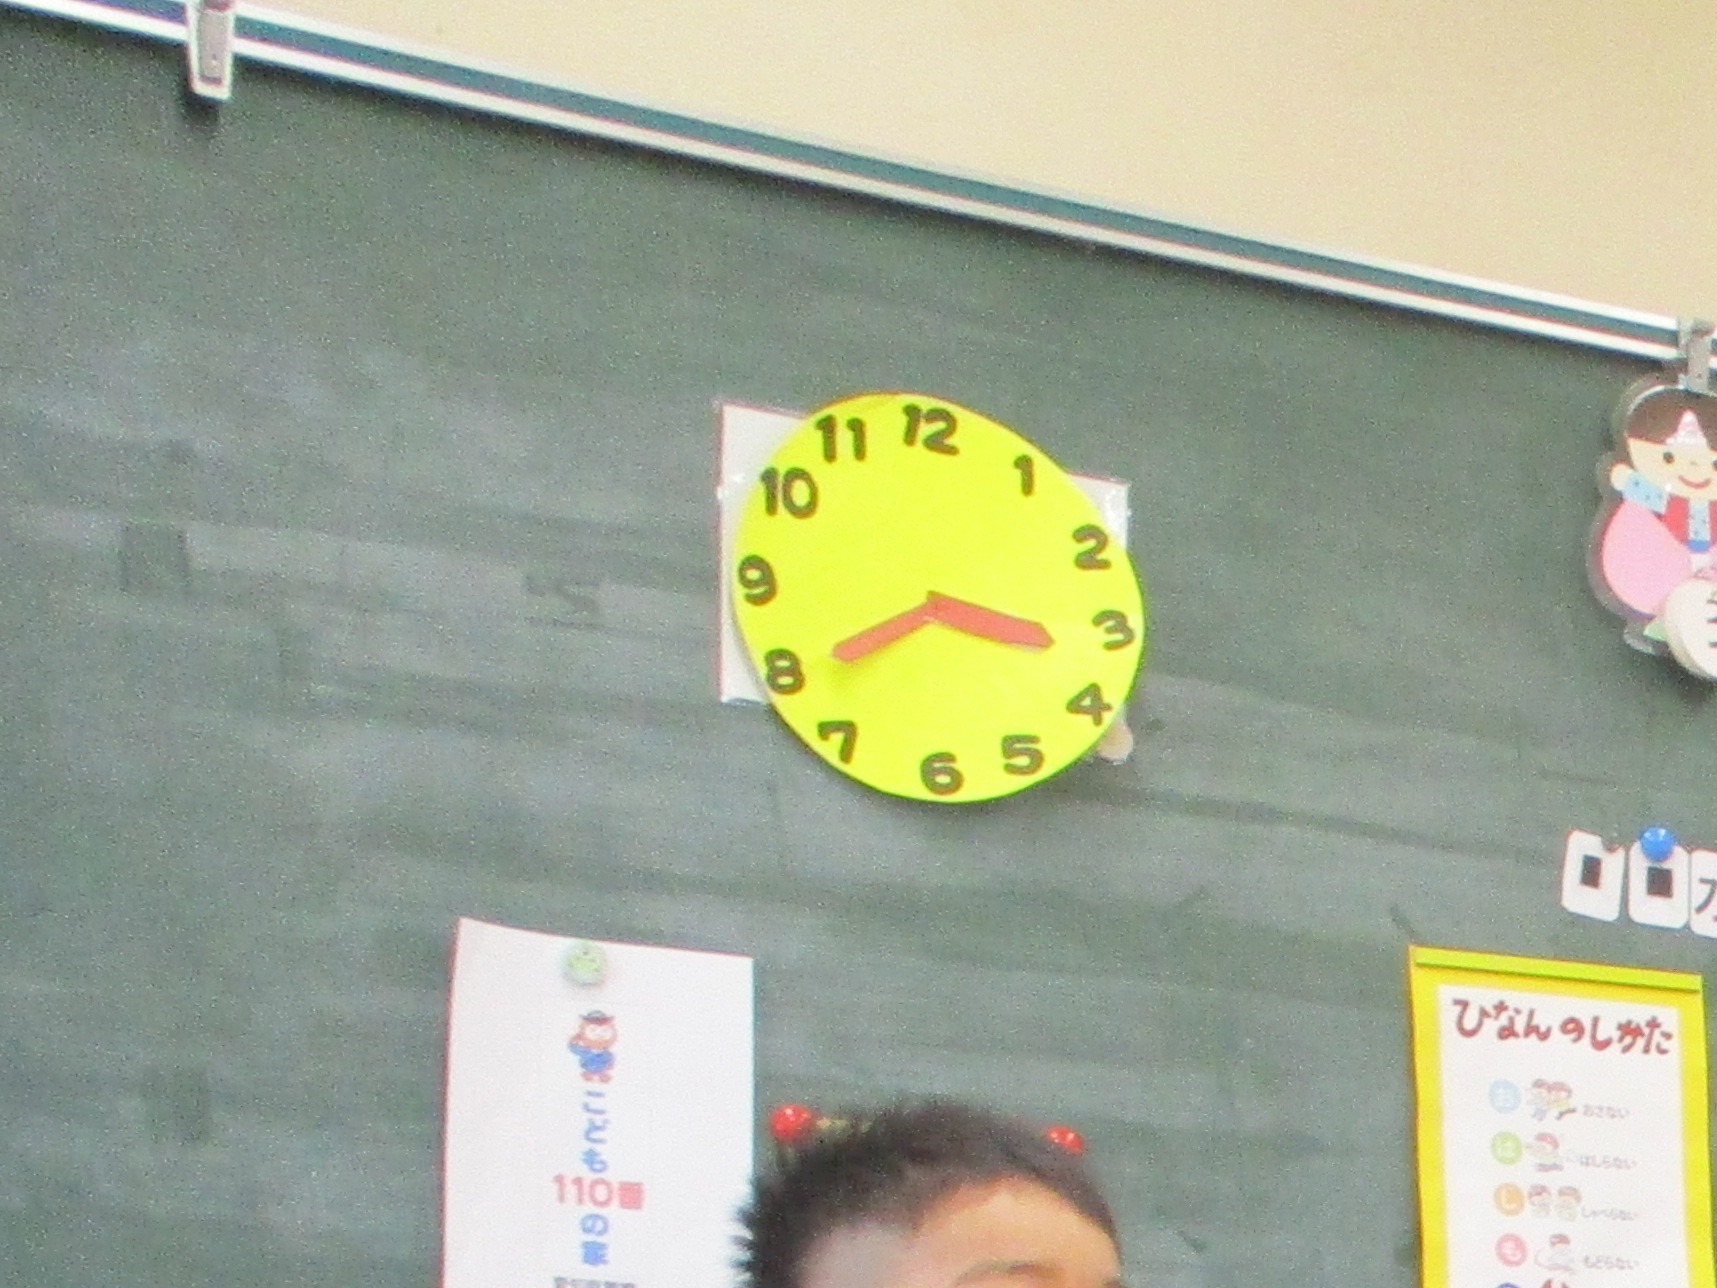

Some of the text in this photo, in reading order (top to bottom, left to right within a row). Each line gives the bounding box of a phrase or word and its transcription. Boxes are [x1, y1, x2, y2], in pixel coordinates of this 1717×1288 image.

[815, 415, 867, 464] 11
[902, 403, 960, 456] 12
[761, 466, 819, 520] 10
[1014, 454, 1035, 497] 1
[1072, 525, 1112, 570] 2
[738, 554, 778, 606] 9
[1092, 610, 1135, 651] 3
[765, 648, 805, 695] 8
[1066, 683, 1112, 727] 4
[817, 720, 858, 764] 7
[1002, 734, 1044, 776] 5
[920, 752, 964, 796] 6
[1452, 997, 1674, 1056] ひなんのしかた
